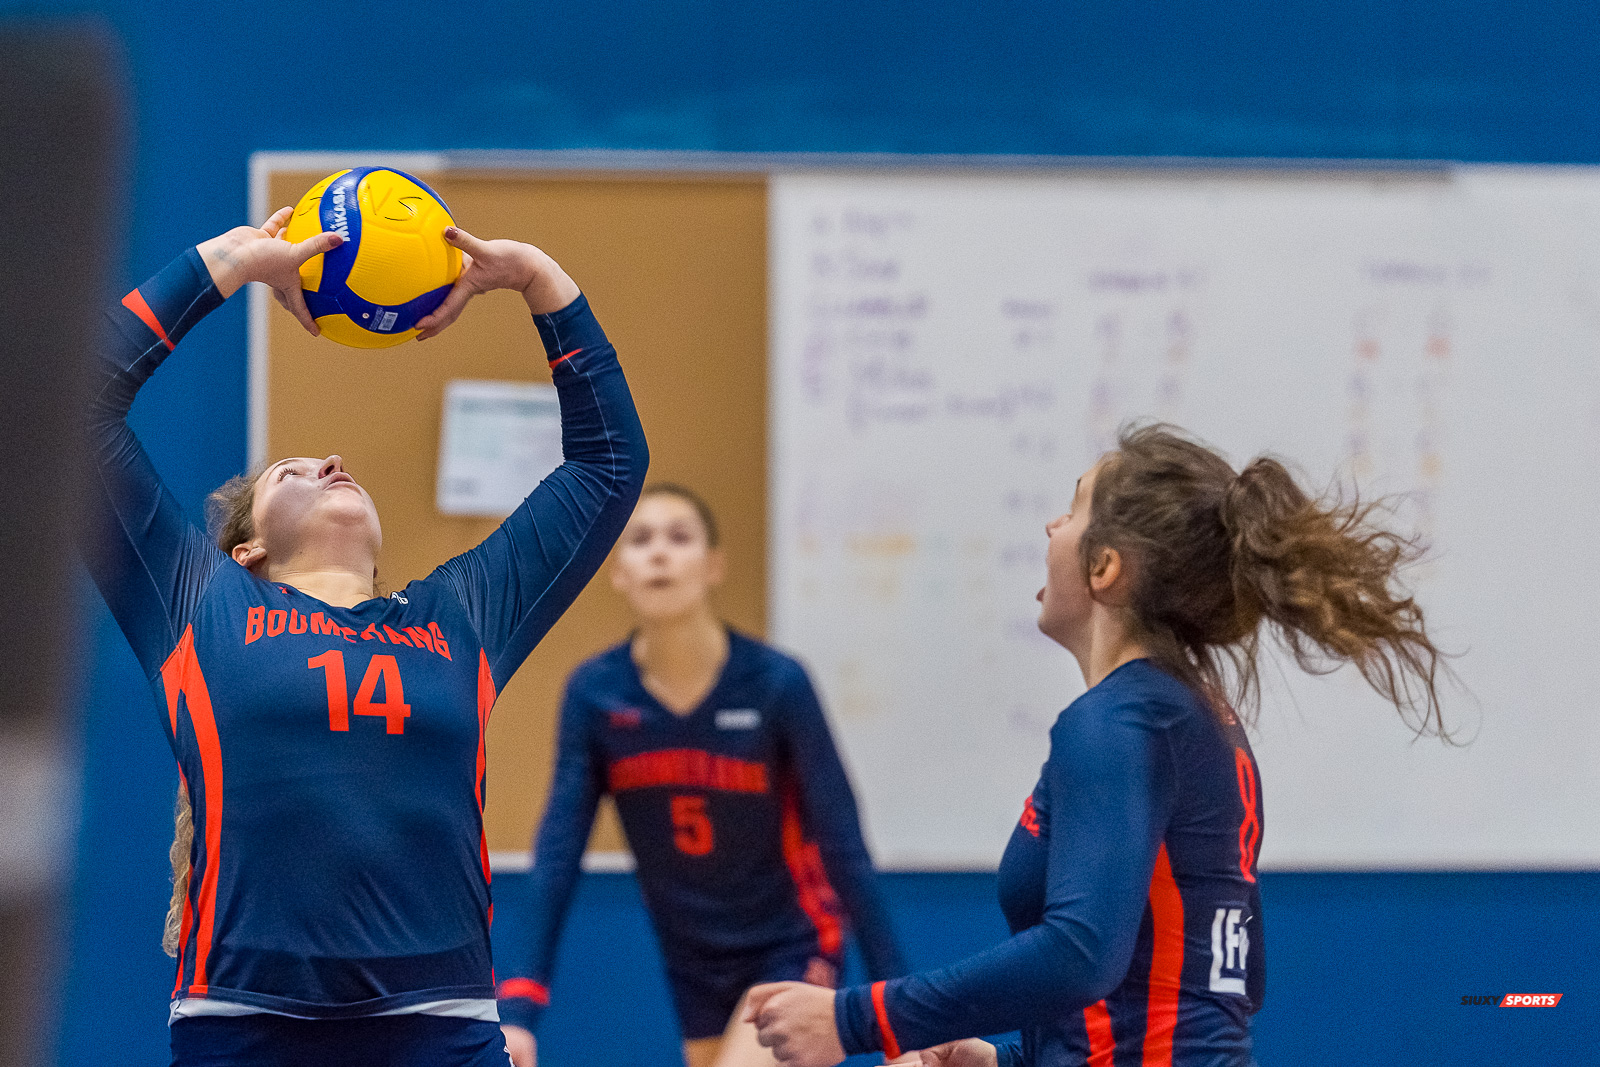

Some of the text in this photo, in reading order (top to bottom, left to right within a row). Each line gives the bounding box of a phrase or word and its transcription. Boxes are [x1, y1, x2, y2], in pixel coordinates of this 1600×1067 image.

[308, 650, 411, 735] 14
[671, 796, 713, 855] 5
[1235, 747, 1259, 883] 8
